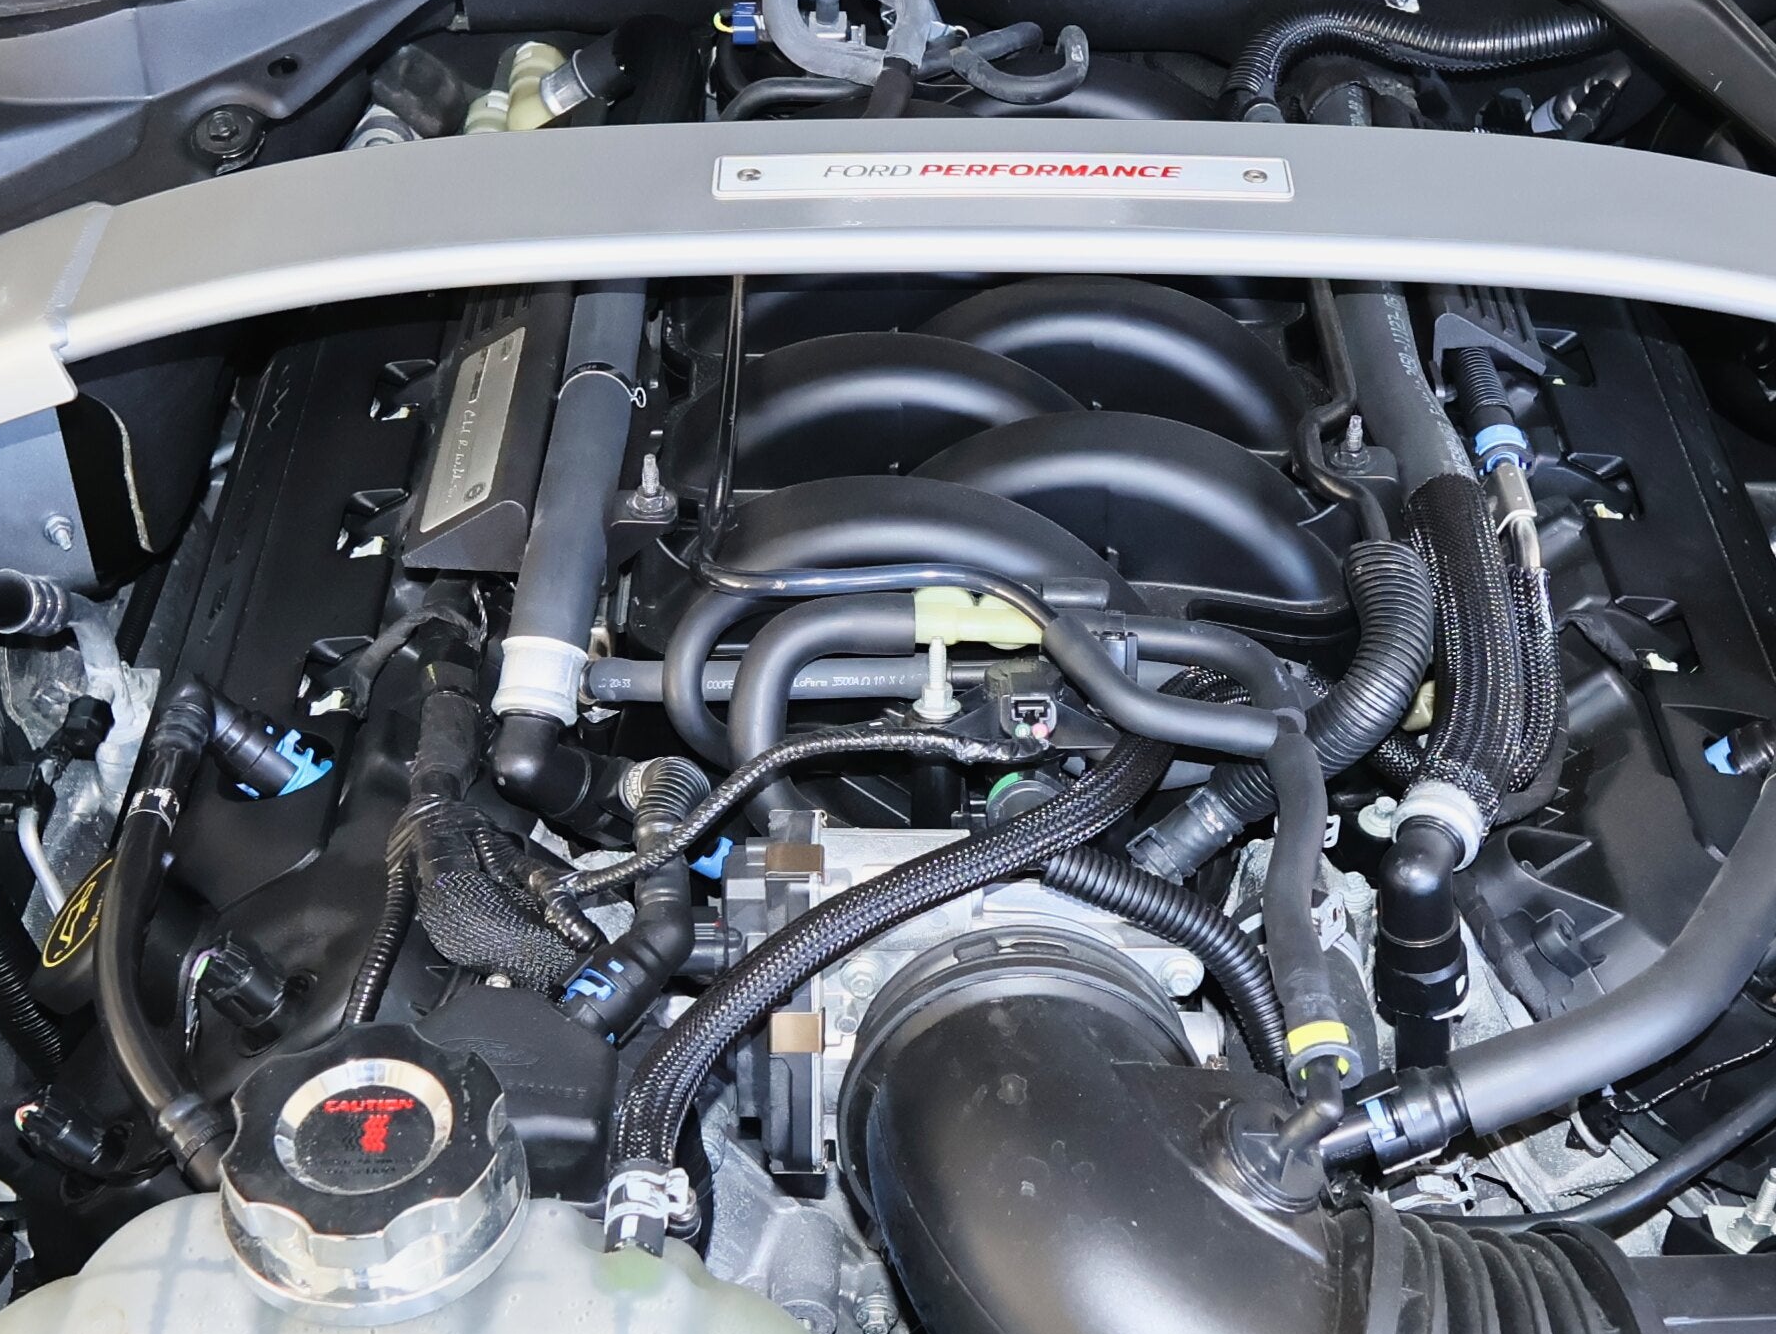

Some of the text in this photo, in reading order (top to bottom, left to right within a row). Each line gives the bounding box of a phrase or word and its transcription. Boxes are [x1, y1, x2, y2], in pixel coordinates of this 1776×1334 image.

[823, 164, 1183, 178] FORD PERFORMANCE
[322, 1097, 417, 1114] CAUTION
